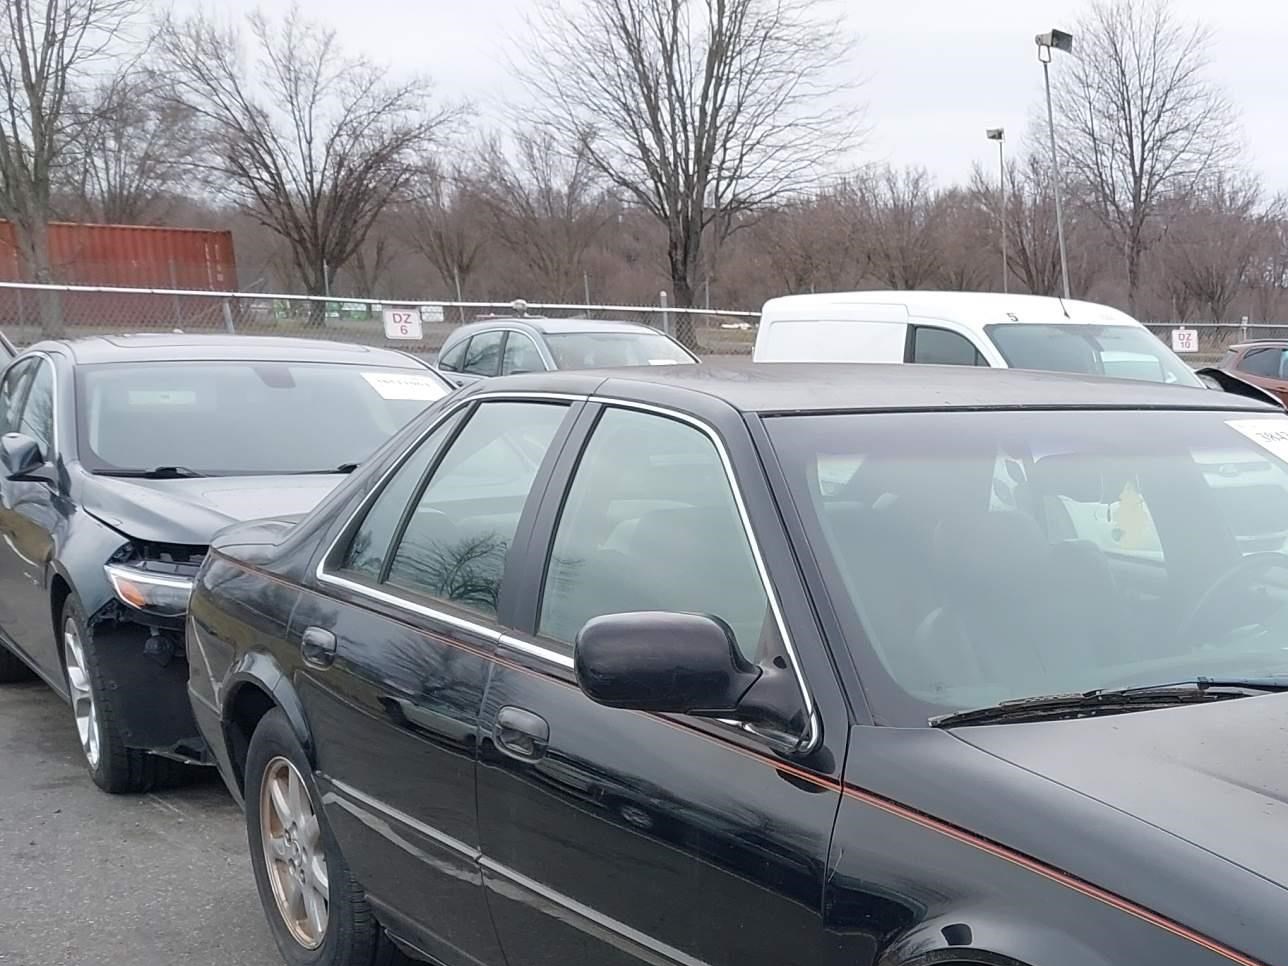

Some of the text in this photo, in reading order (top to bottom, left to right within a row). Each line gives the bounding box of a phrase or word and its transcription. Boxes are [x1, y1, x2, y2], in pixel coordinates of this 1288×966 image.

[392, 313, 412, 324] DZ
[400, 325, 409, 335] 6
[1178, 333, 1193, 342] DZ
[1179, 341, 1191, 349] 10
